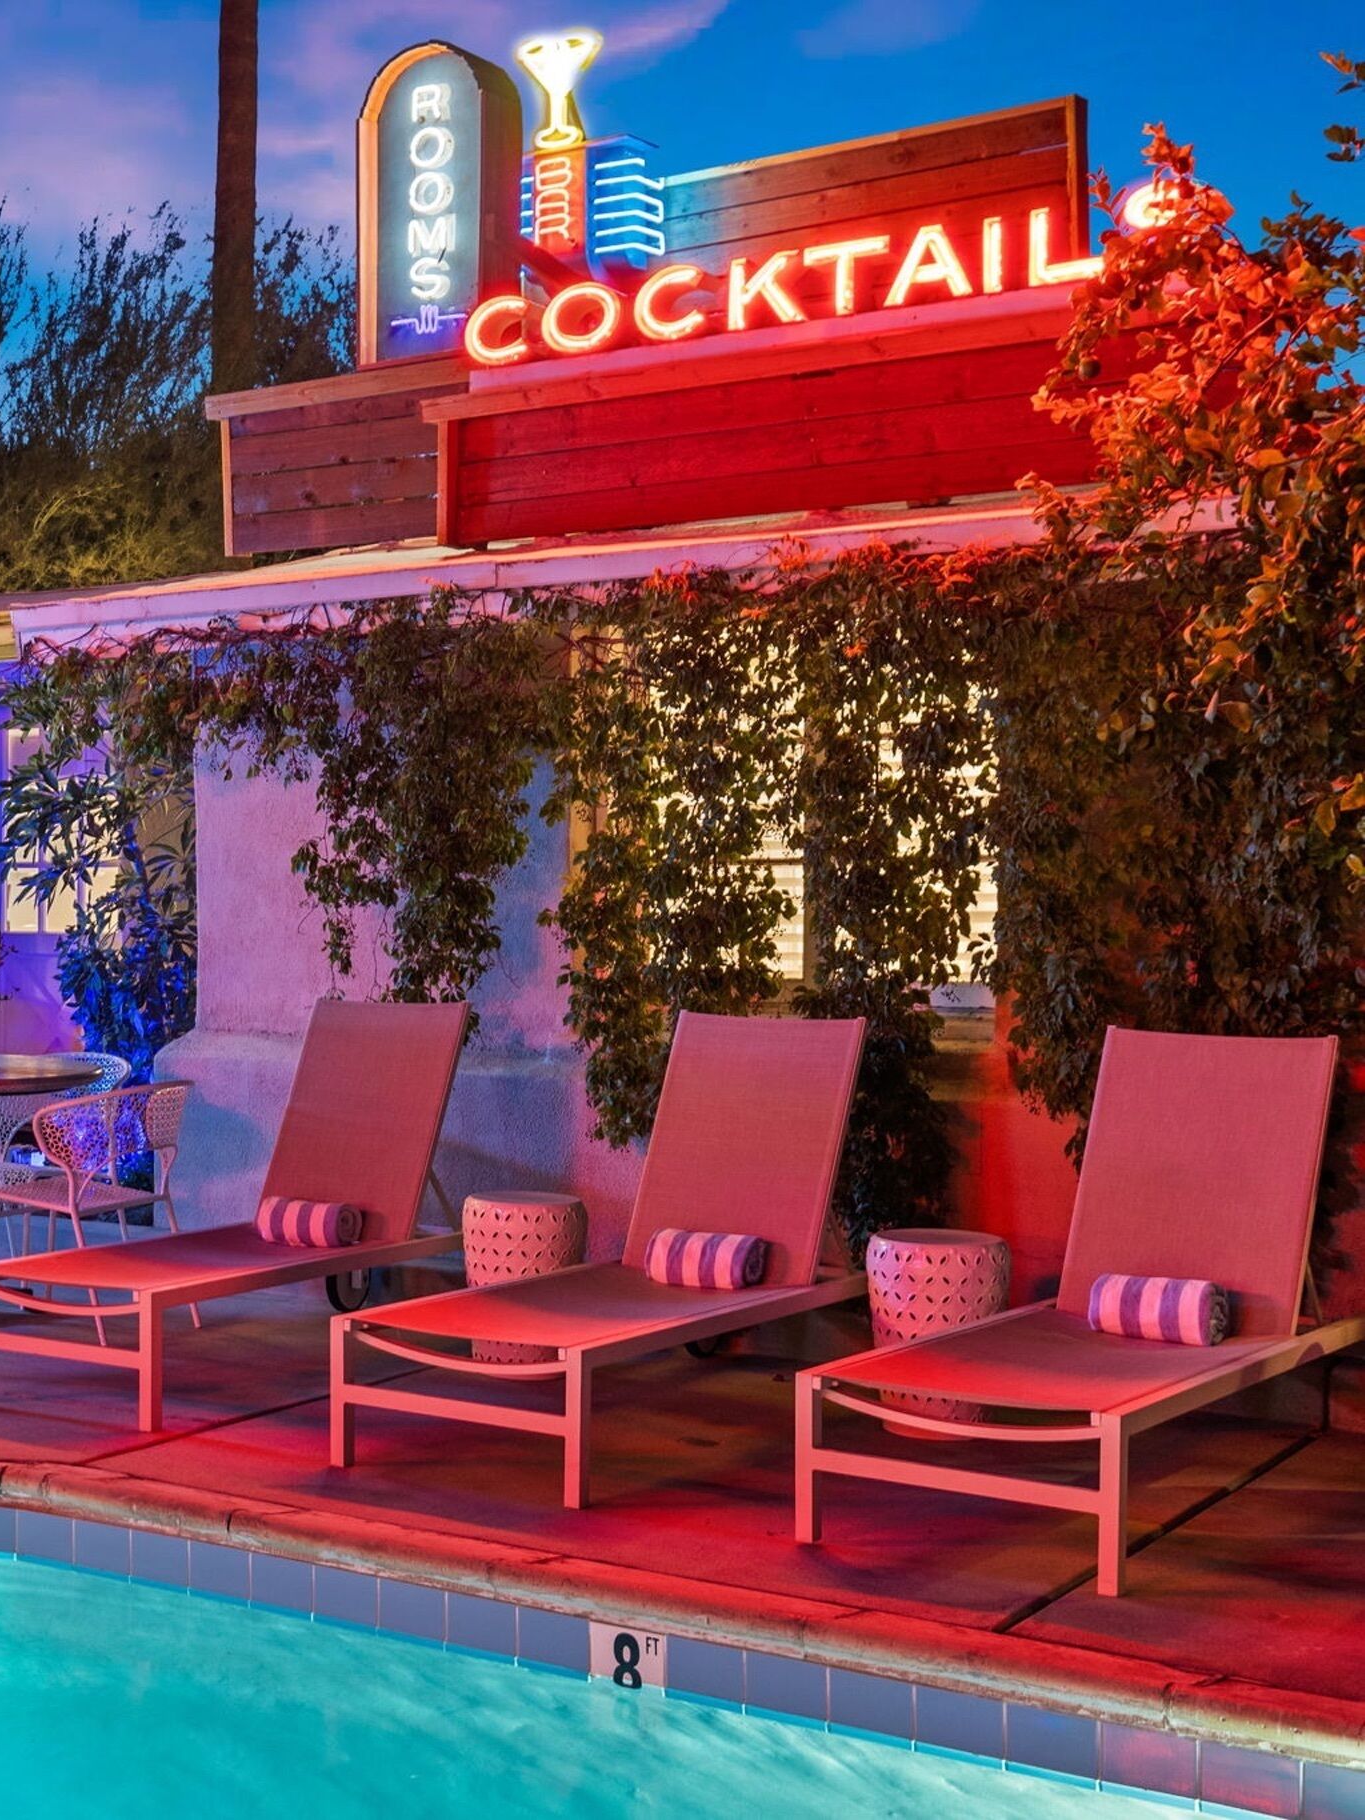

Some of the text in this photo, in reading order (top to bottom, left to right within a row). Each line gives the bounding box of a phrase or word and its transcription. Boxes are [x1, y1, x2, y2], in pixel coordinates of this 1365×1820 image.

[408, 83, 455, 300] ROOMS
[534, 155, 574, 247] BAR
[614, 1633, 659, 1689] 8 FT
